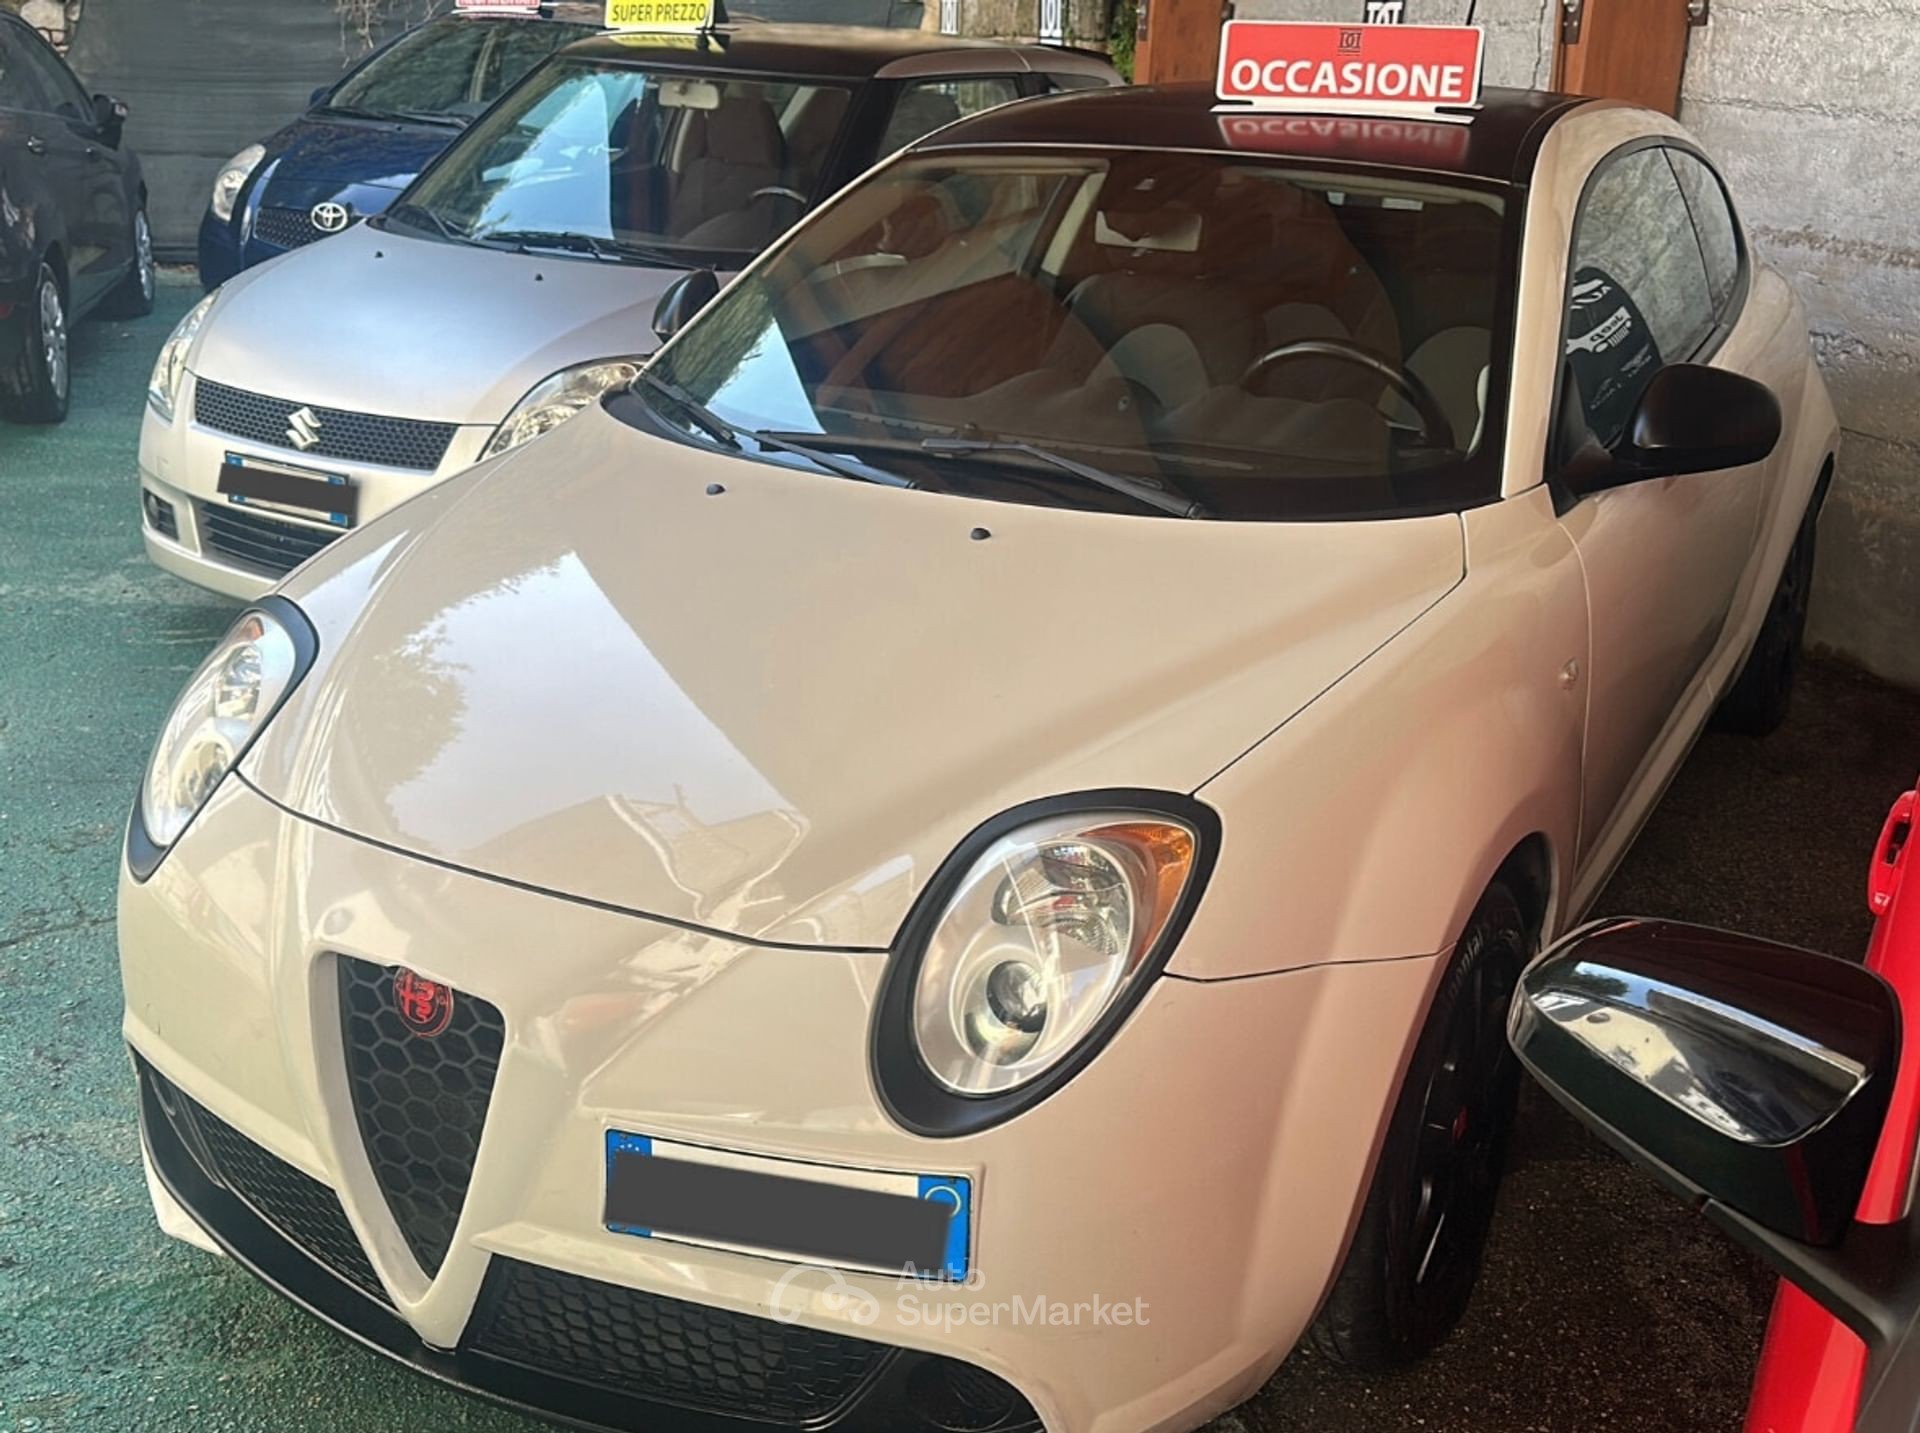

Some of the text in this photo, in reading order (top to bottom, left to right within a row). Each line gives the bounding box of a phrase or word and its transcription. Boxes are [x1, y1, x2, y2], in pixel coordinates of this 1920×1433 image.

[612, 3, 707, 21] SUPER PREZZO
[1230, 58, 1464, 97] OCCASIONE
